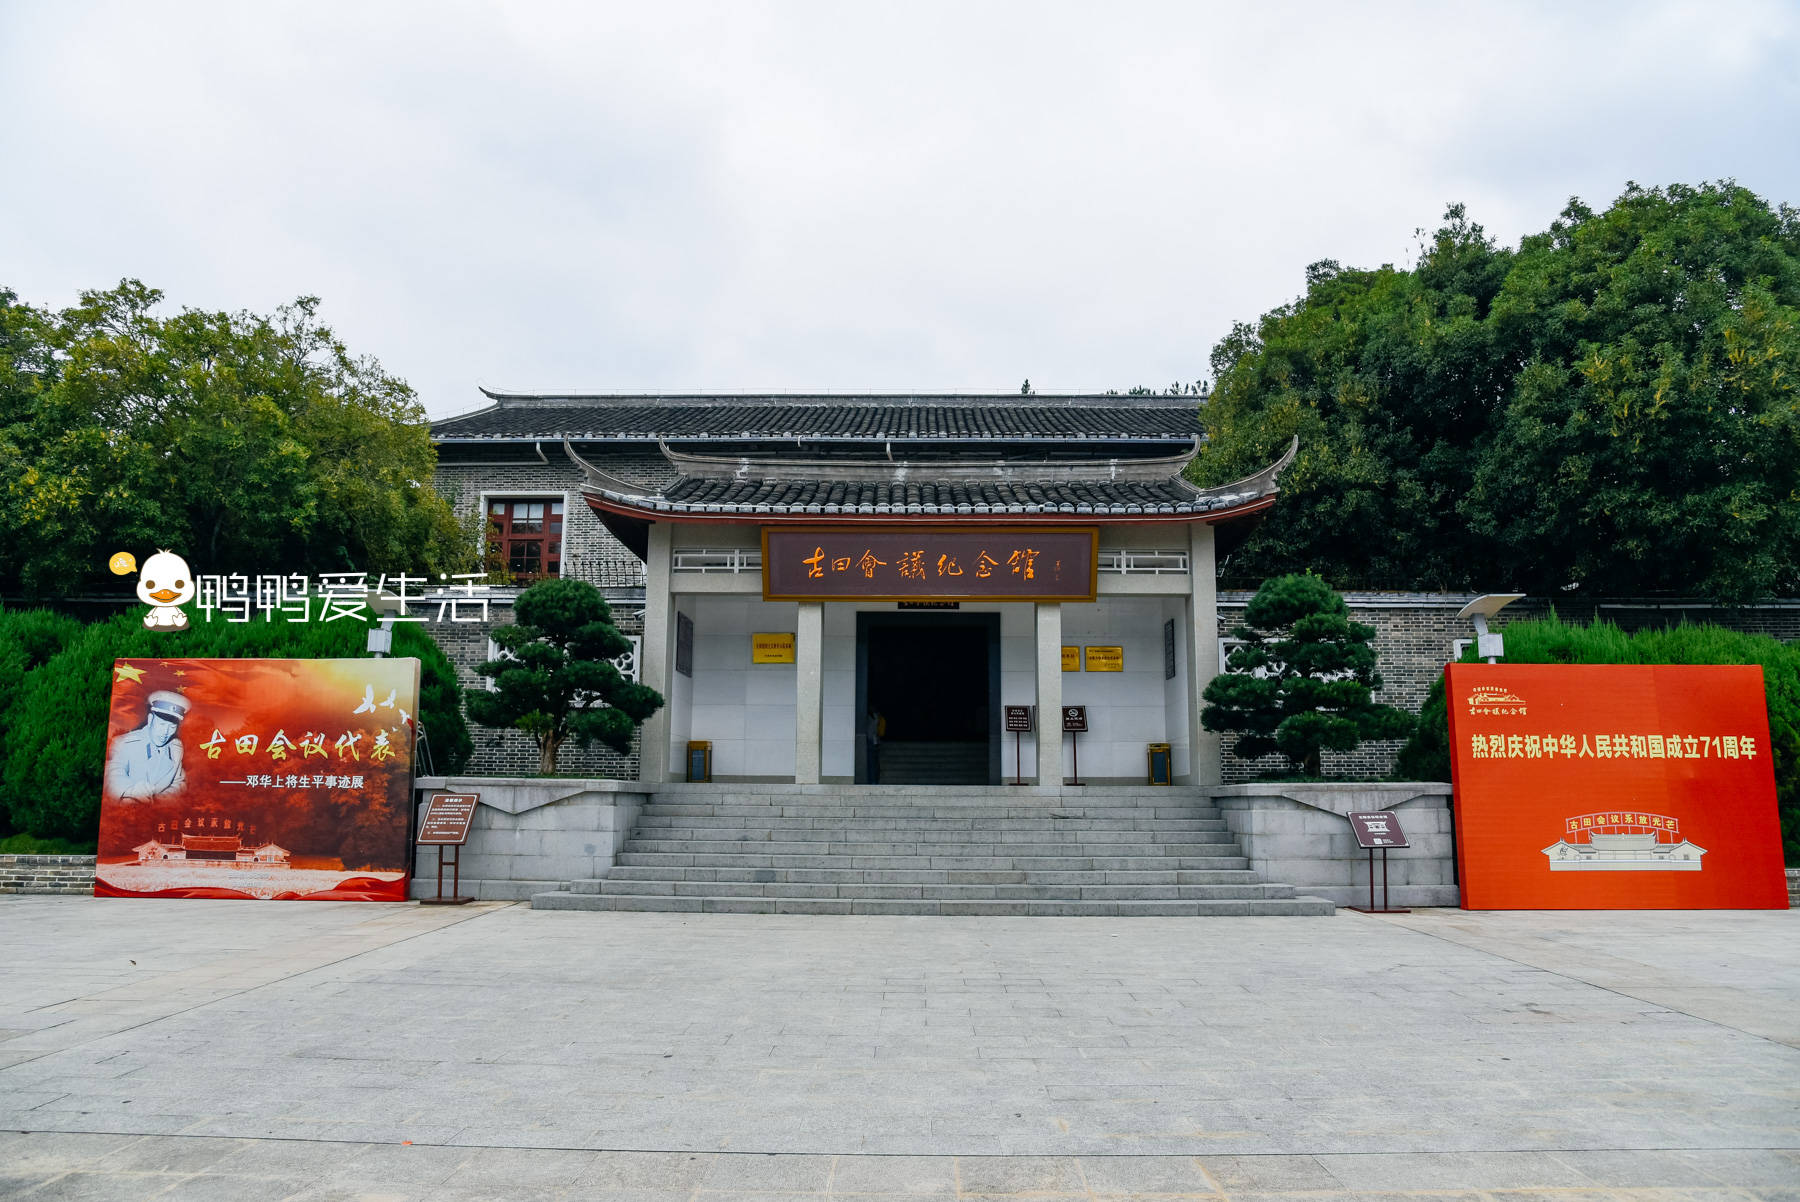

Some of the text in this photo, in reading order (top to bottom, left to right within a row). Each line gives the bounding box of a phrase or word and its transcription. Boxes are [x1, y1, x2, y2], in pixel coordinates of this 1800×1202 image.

[200, 728, 396, 762] 古田会议代表
[1471, 733, 1757, 760] 热烈庆祝中华人民共和国成立71周年
